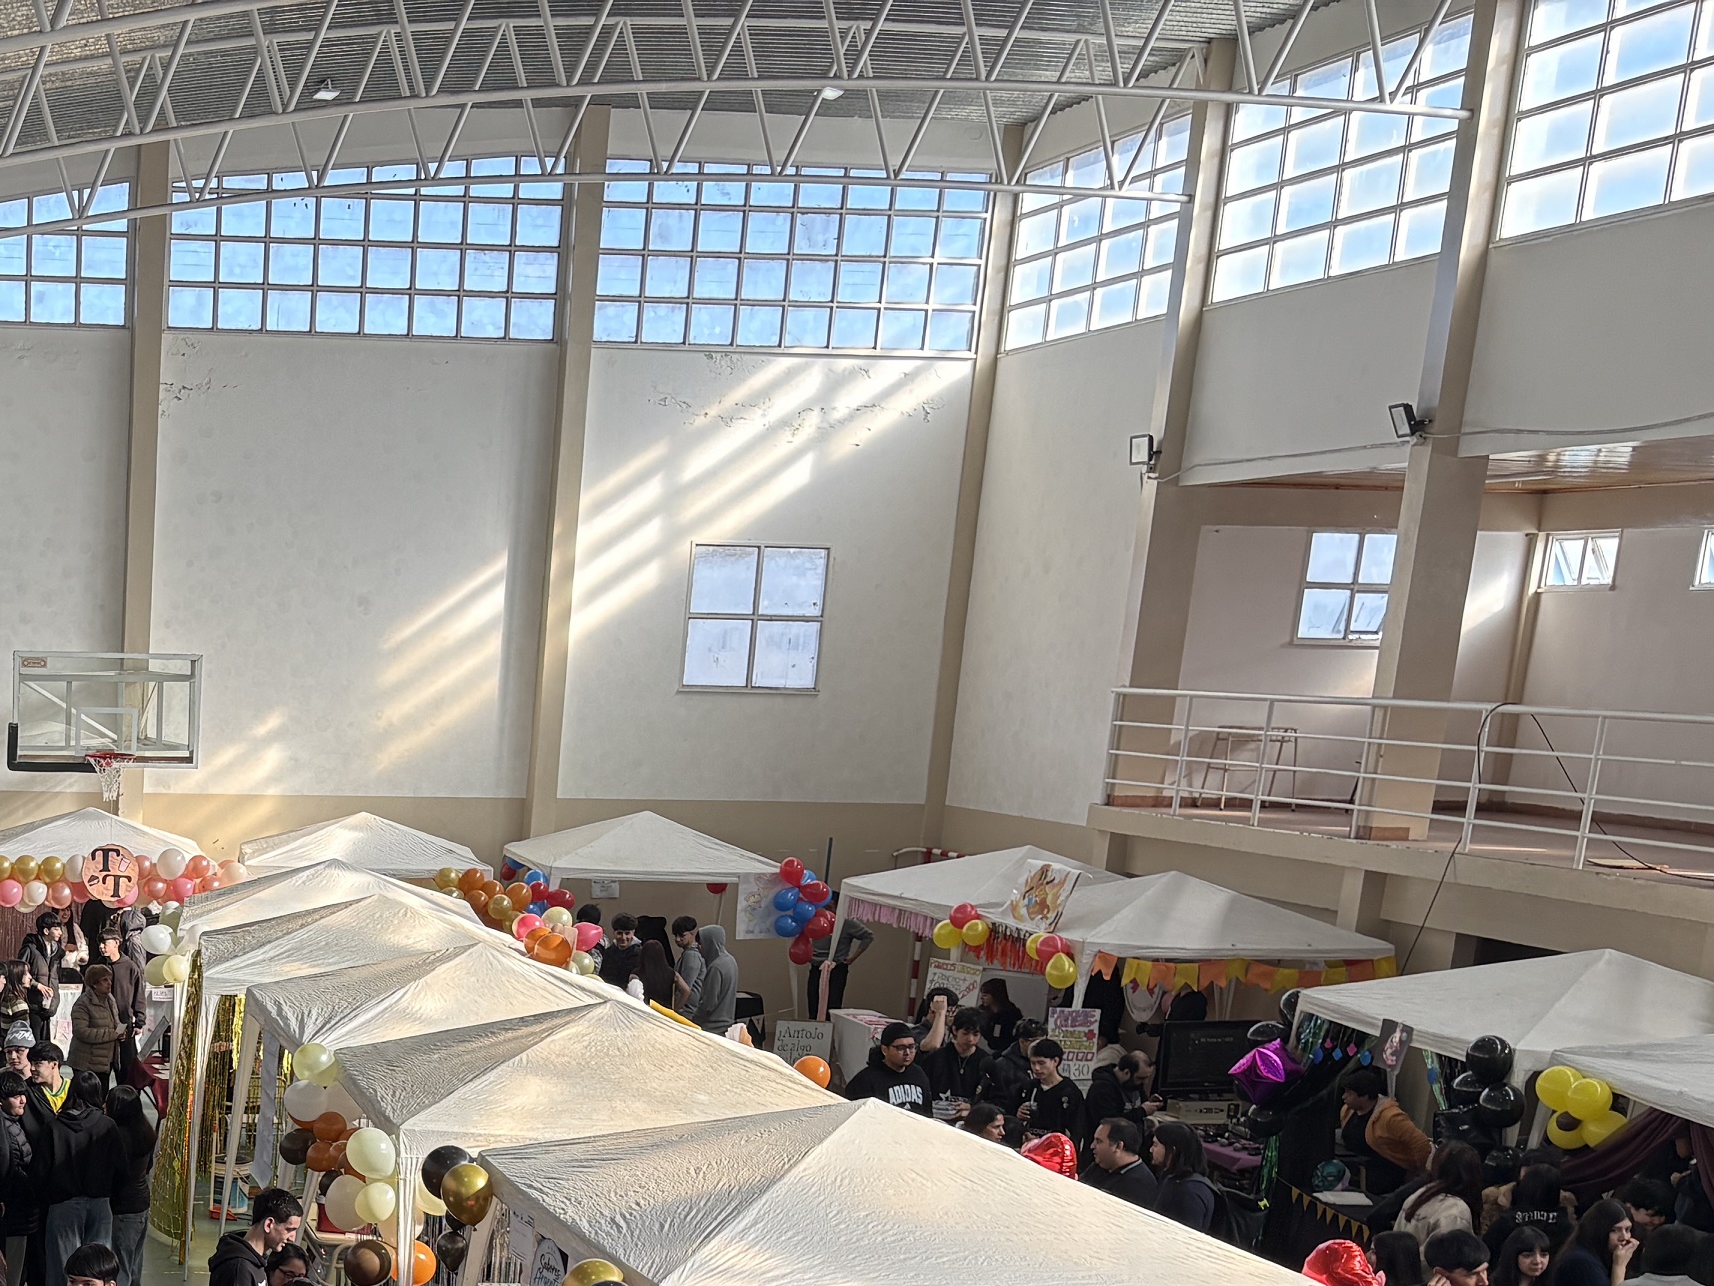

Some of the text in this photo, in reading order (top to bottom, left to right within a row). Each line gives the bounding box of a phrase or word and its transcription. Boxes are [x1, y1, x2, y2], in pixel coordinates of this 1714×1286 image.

[777, 1039, 812, 1056] de algo
[888, 1084, 923, 1105] ADIDAS
